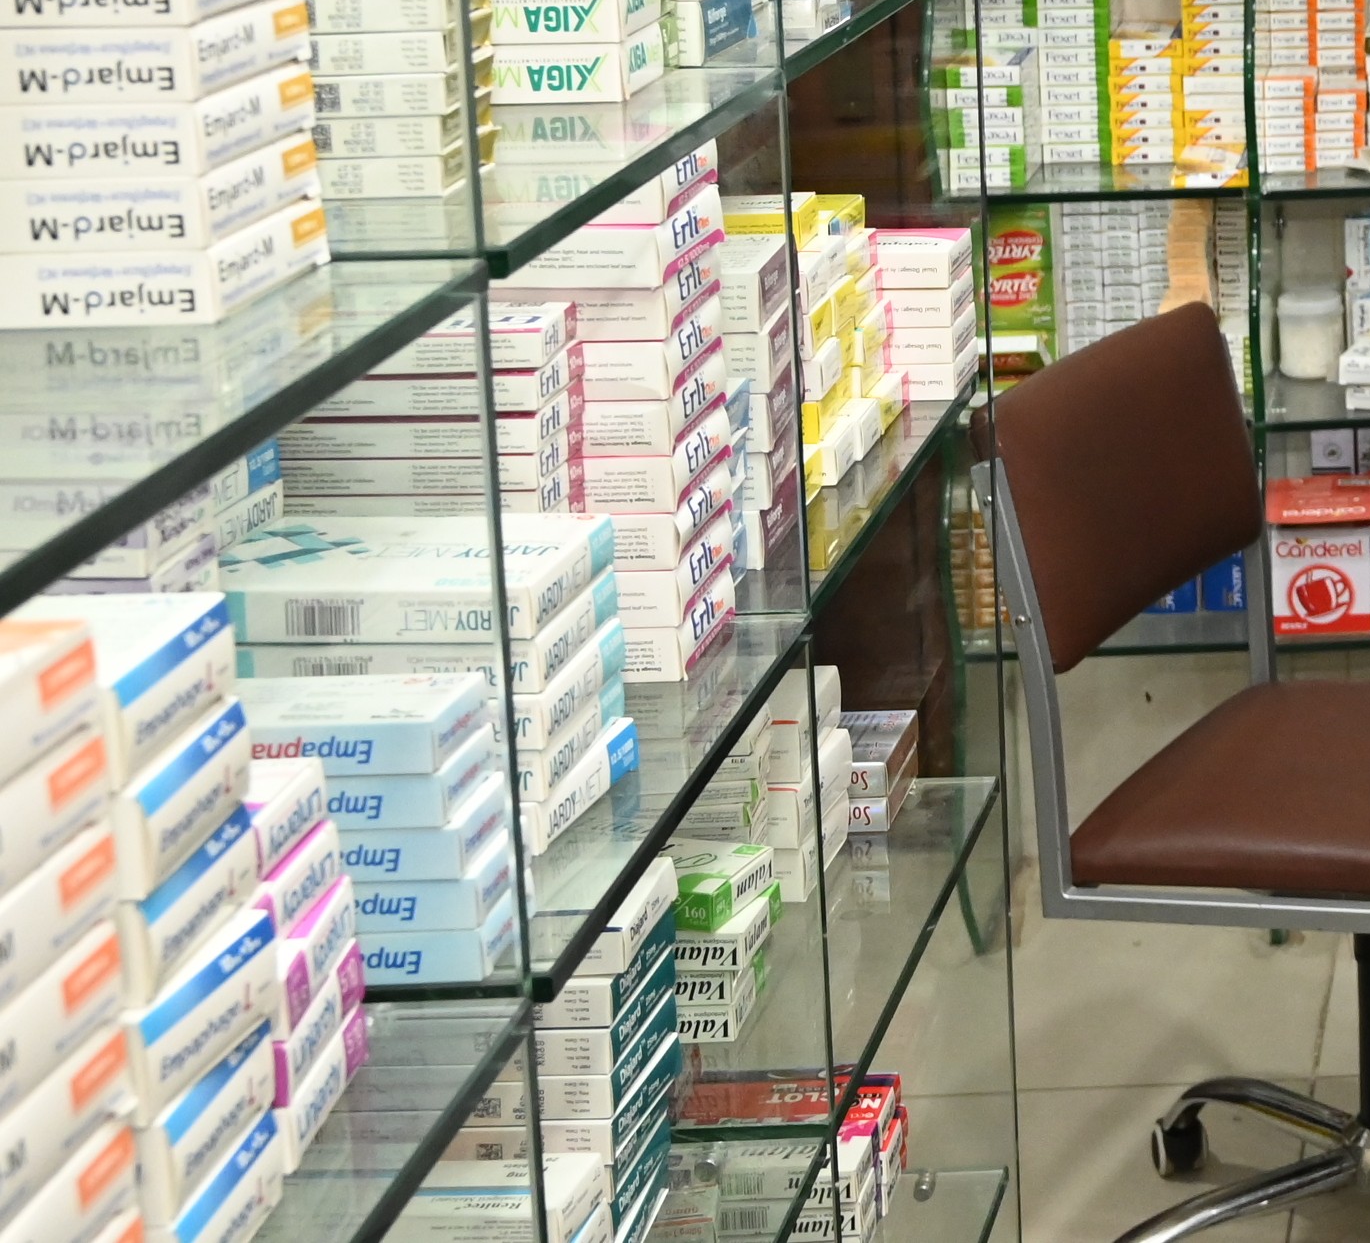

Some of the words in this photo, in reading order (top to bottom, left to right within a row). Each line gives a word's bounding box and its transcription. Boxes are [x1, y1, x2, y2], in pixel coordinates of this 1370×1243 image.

[18, 65, 178, 93] Emjard-M
[529, 56, 606, 92] XIGA
[23, 140, 181, 167] Emjard-M
[29, 214, 187, 241] Emjard-M
[671, 210, 699, 249] Erli
[40, 287, 197, 316] Emjard-M
[677, 322, 704, 360] Erli
[681, 376, 708, 420] Erli
[685, 430, 711, 474] Erli
[690, 488, 715, 529] Erli
[690, 540, 715, 586] Erli
[1275, 537, 1362, 559] Canderel
[690, 600, 717, 642] Erli
[852, 770, 868, 789] So
[853, 806, 870, 826] So
[684, 905, 706, 920] 160
